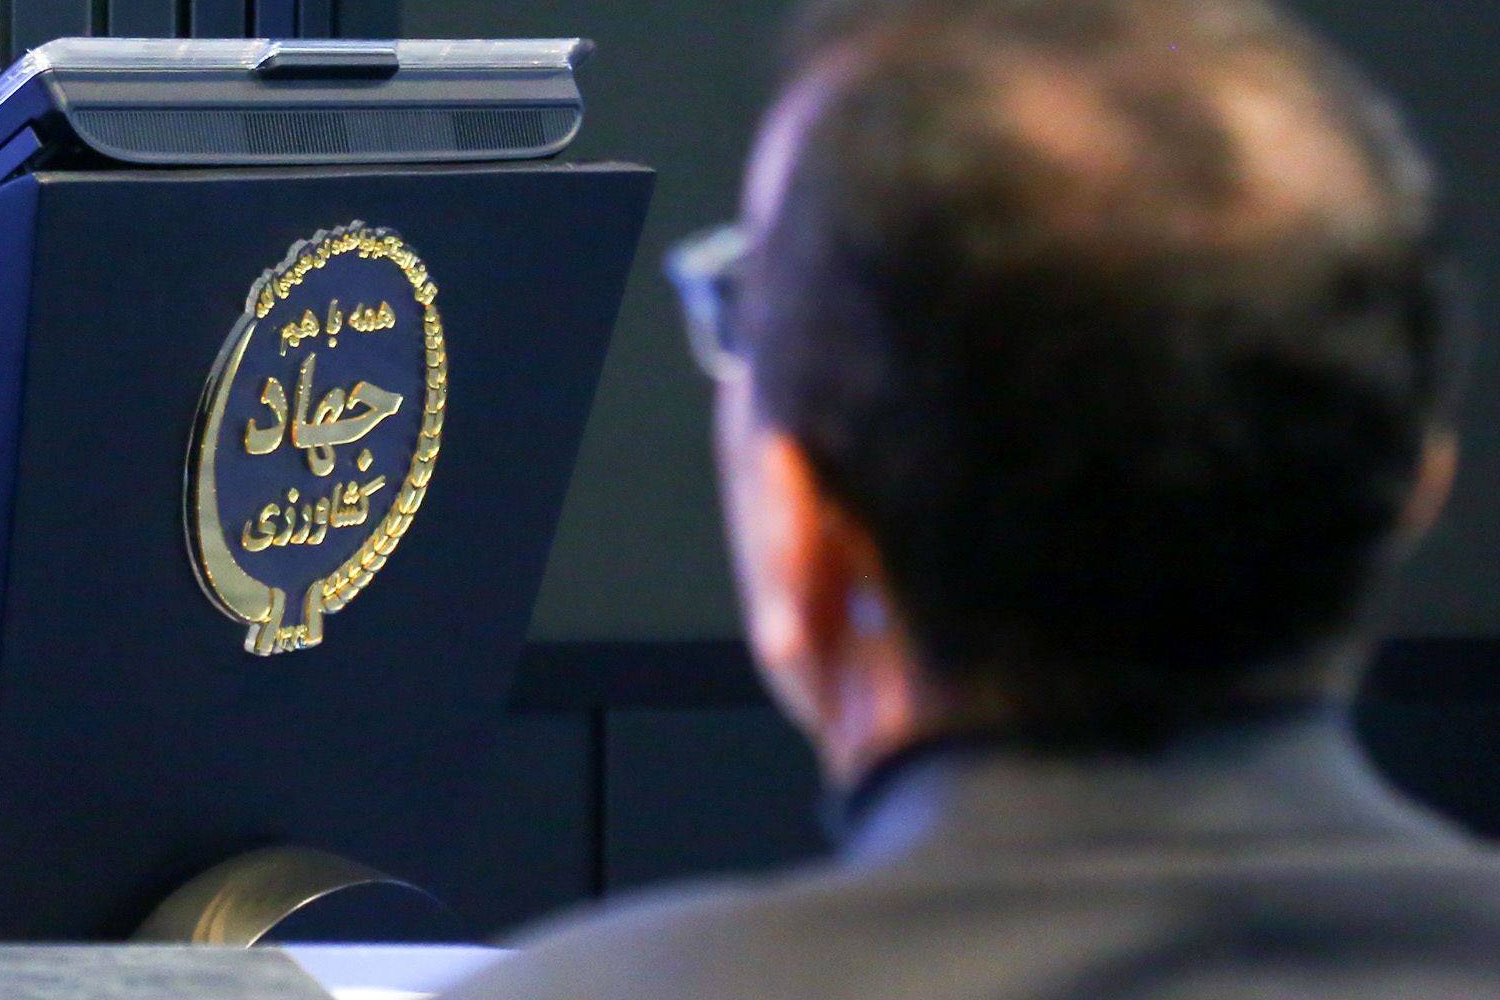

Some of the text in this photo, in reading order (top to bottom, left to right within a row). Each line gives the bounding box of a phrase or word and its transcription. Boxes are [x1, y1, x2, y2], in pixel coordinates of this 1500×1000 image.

[279, 299, 396, 357] همه با هم
[244, 352, 404, 477] جهاد
[241, 474, 387, 552] کشاورزی
